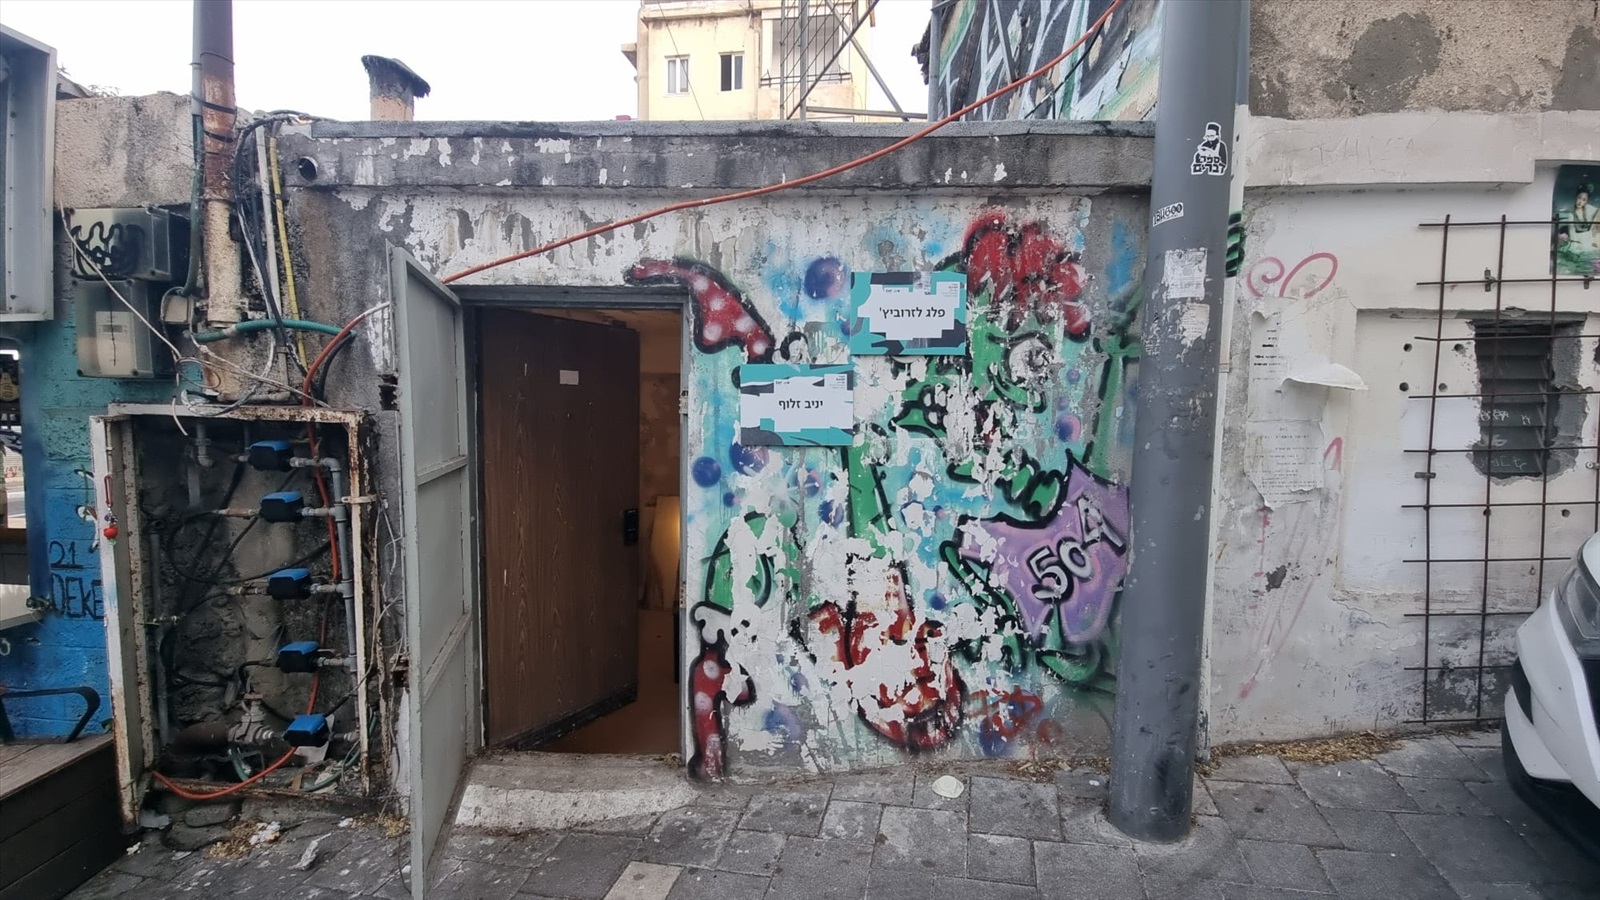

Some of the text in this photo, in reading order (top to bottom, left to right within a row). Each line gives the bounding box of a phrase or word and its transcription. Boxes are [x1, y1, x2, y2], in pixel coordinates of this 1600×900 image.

[879, 307, 946, 319] פלג לזרוביץ'
[778, 398, 824, 410] יניב זלוף
